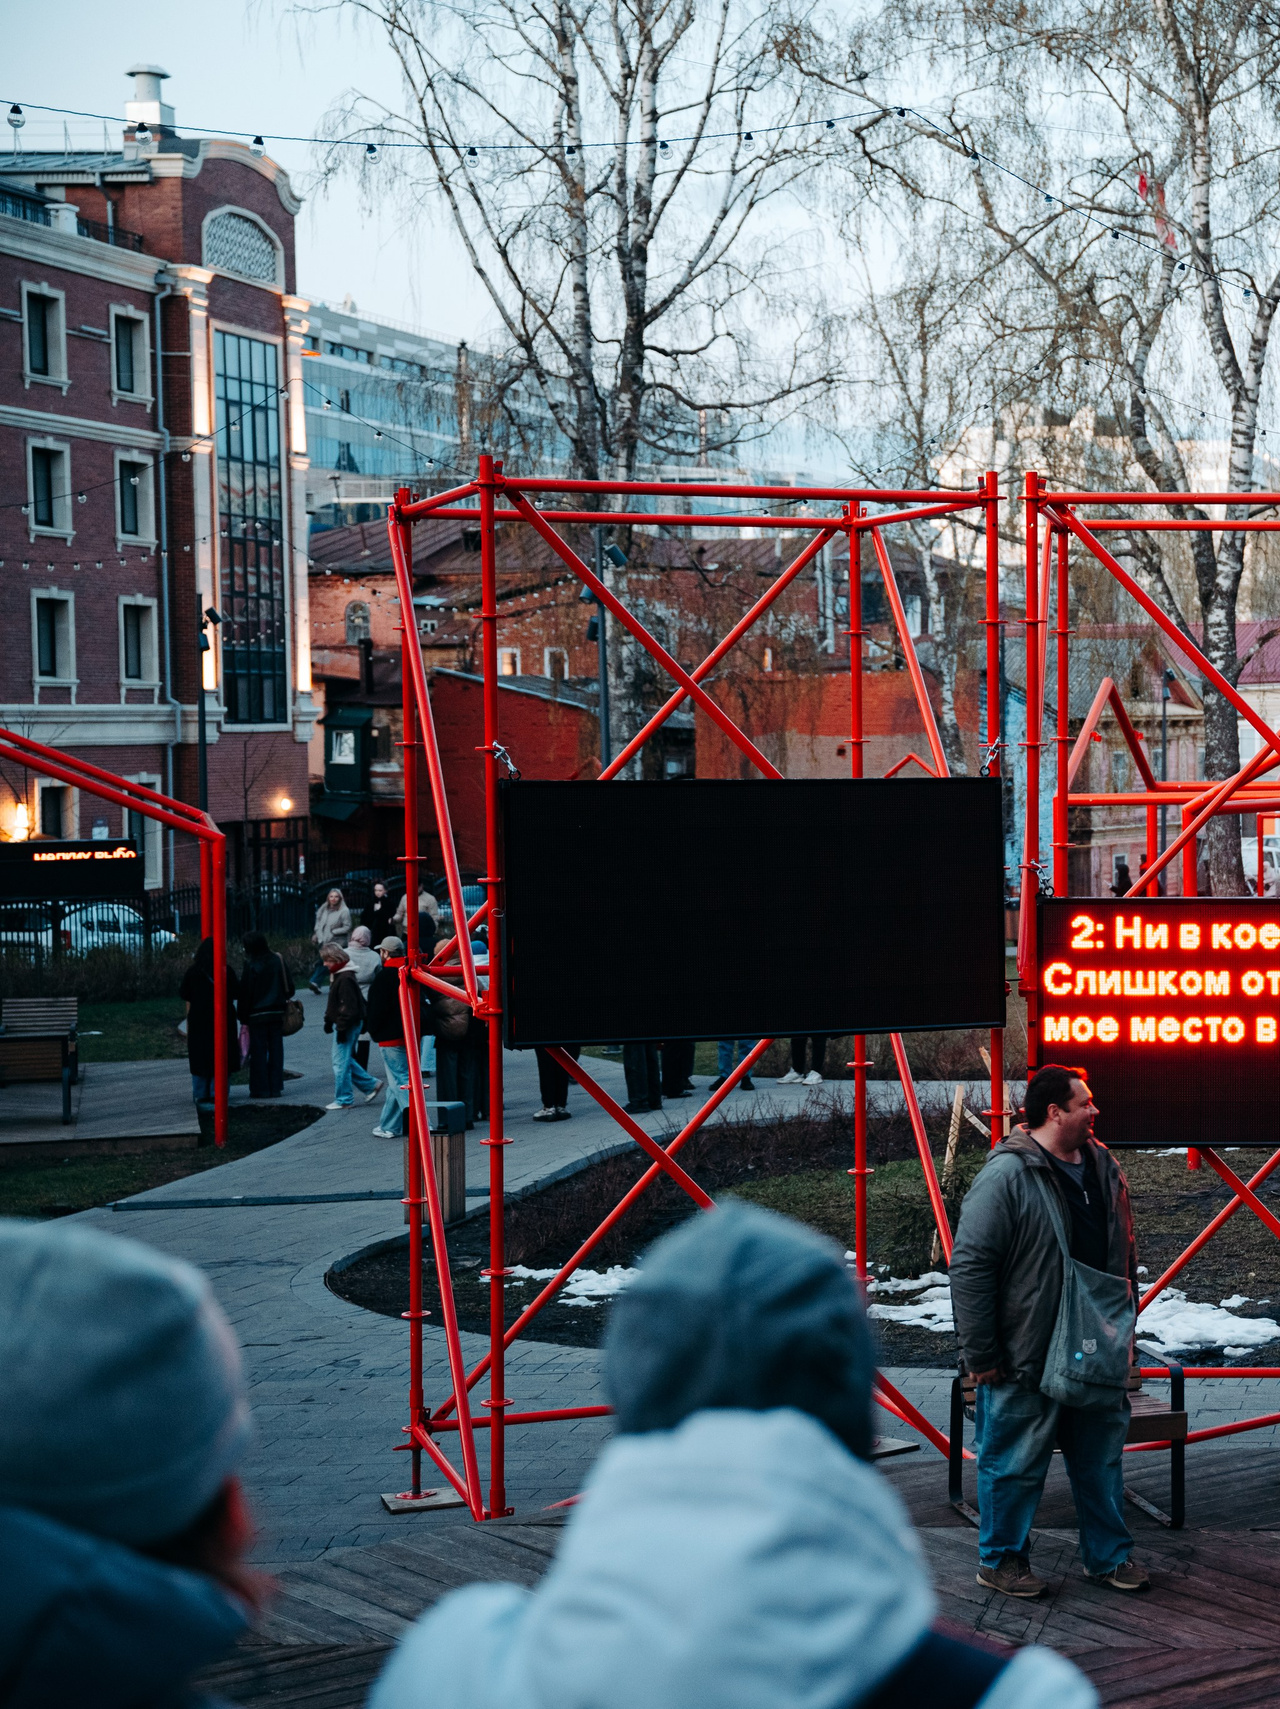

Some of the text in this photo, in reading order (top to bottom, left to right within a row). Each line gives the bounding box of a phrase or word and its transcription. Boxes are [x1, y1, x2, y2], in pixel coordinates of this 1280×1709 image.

[1070, 915, 1105, 949] 2:
[1114, 915, 1169, 949] Ни
[1179, 922, 1201, 950] в
[1043, 962, 1231, 996] Слишком
[1044, 1016, 1120, 1042] мое
[1130, 1016, 1245, 1043] место
[1256, 1016, 1277, 1043] в
